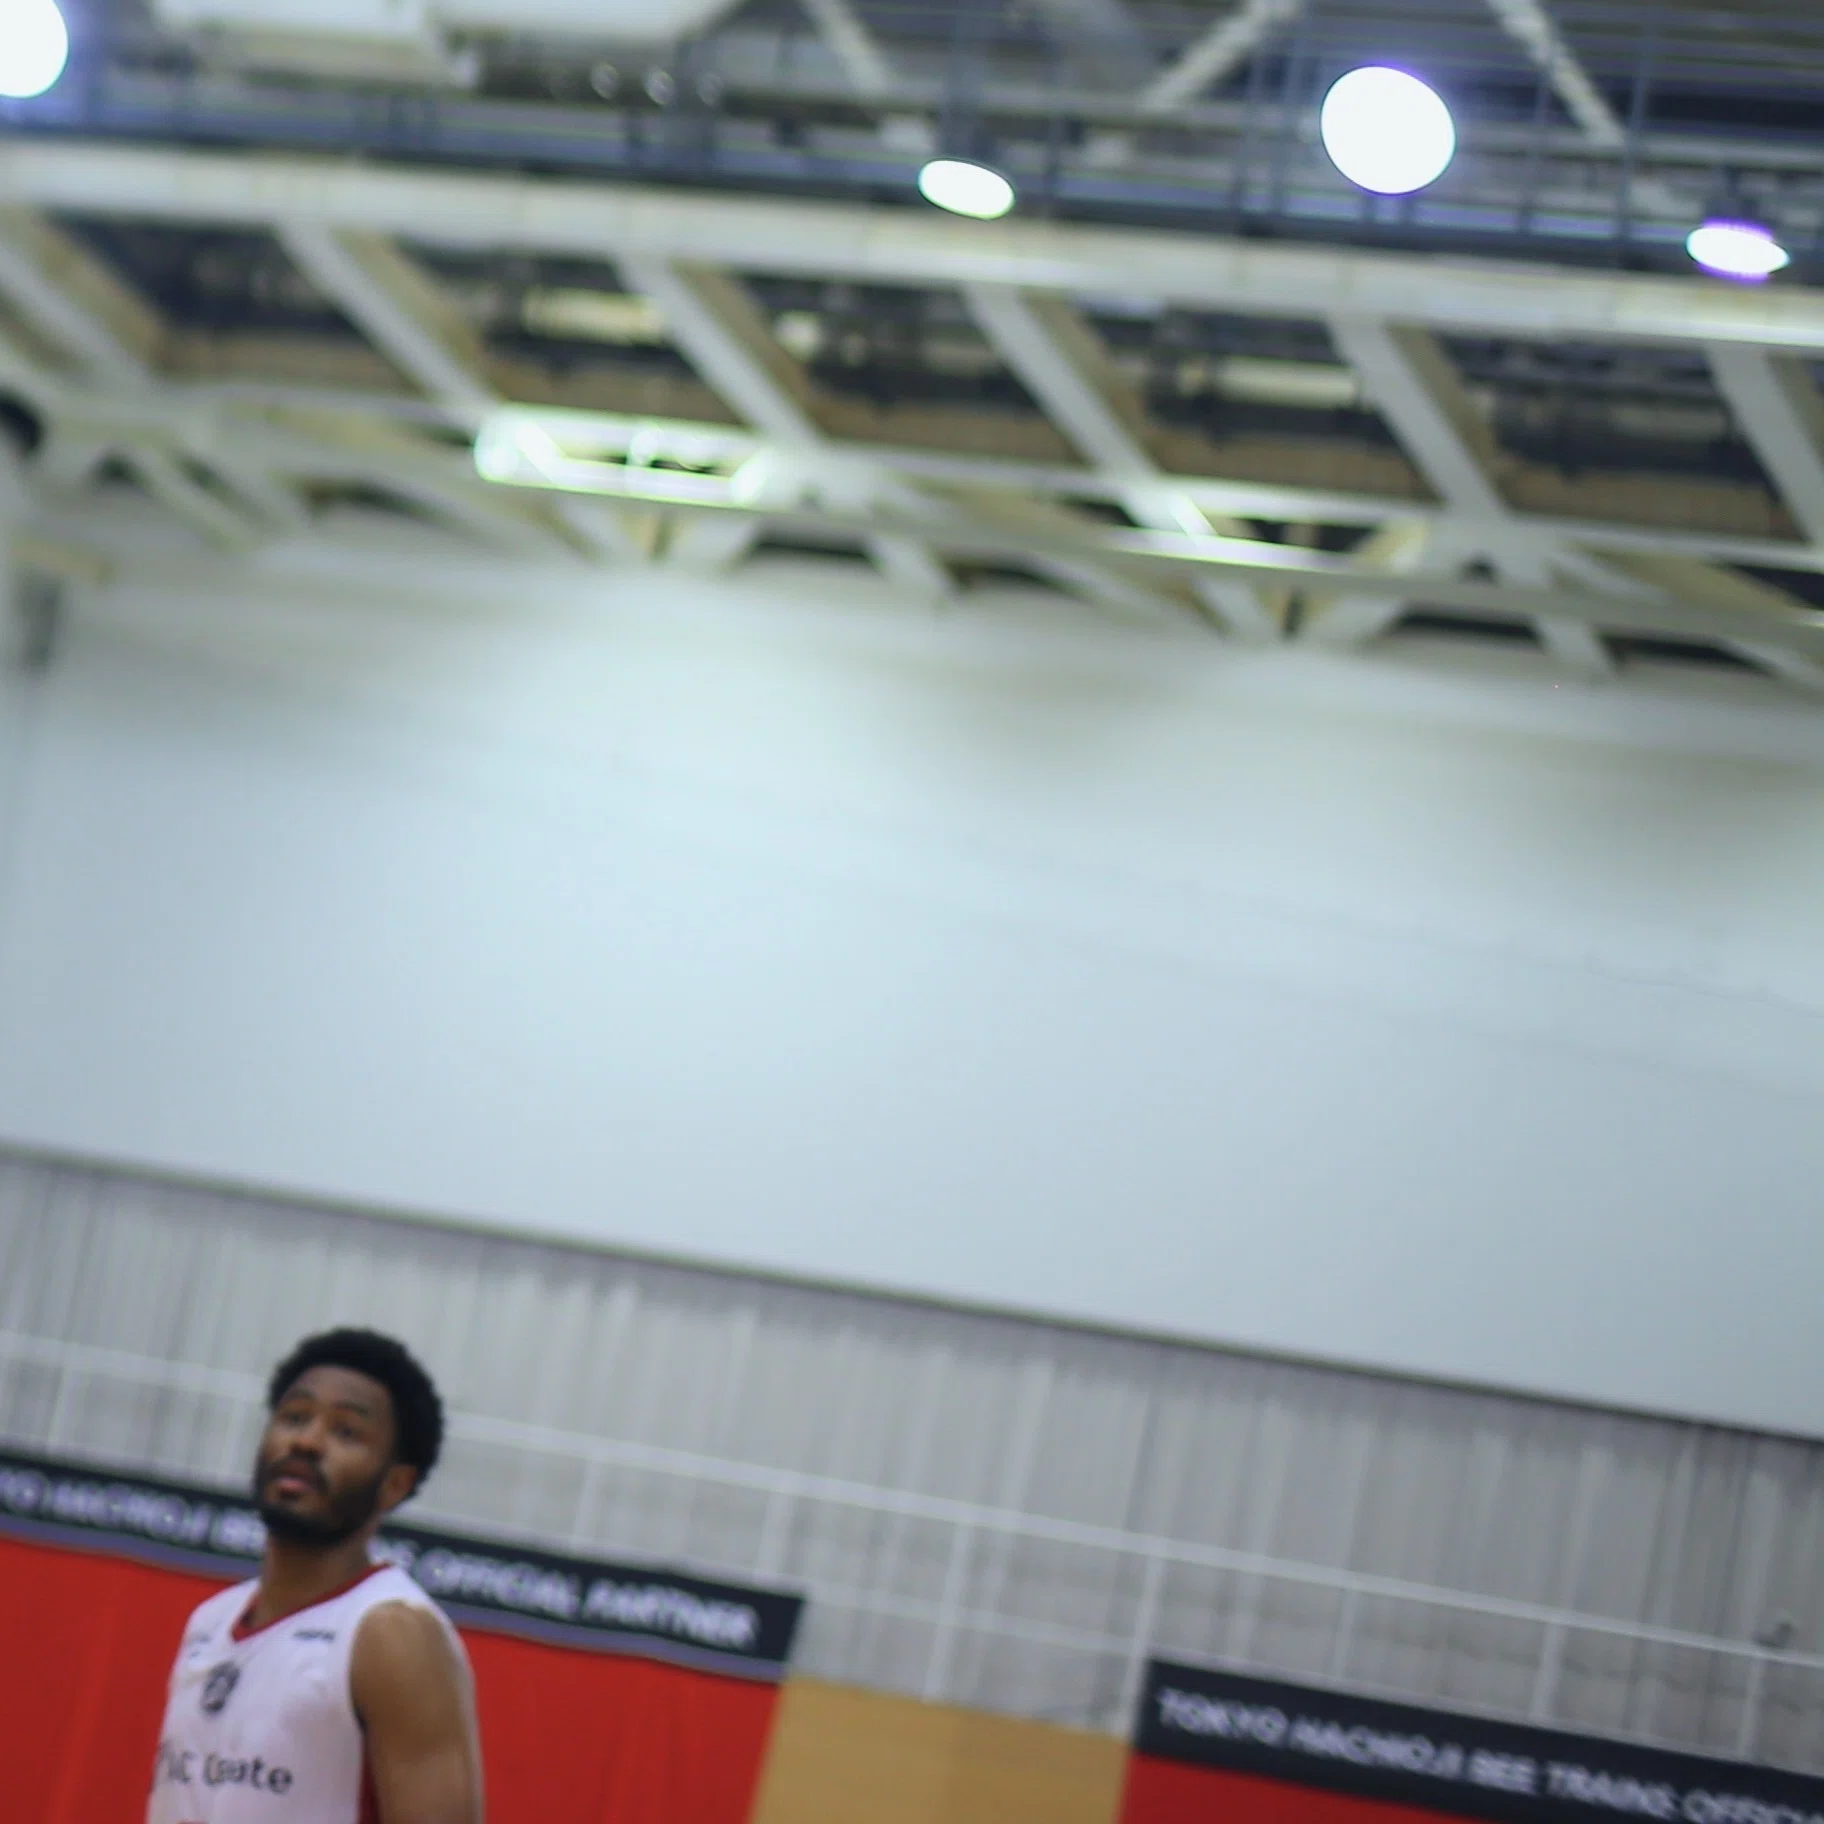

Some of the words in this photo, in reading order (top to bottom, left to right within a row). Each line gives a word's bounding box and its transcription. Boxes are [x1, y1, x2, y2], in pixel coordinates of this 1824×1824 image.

[420, 1547, 578, 1618] OFFICIAL
[582, 1580, 761, 1646] PARTNER
[1158, 1688, 1288, 1749] TOKYO
[1468, 1748, 1539, 1797] BEE
